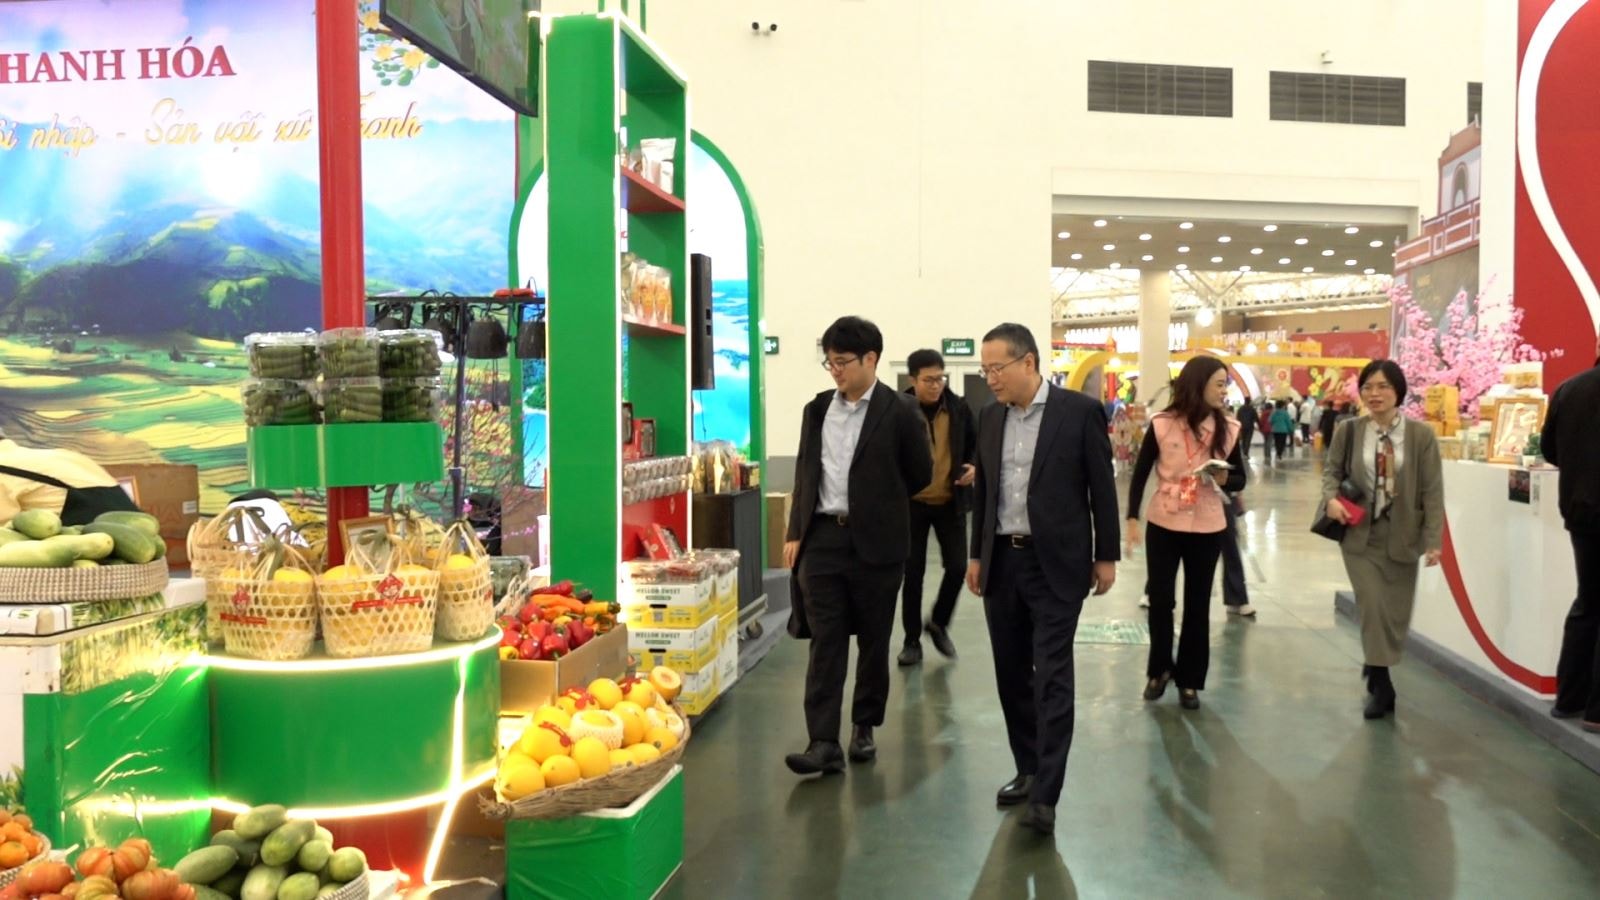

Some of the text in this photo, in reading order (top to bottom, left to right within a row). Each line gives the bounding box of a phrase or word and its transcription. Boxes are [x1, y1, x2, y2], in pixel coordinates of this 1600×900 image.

[137, 36, 237, 79] HÓA
[30, 113, 99, 157] nhập
[145, 97, 202, 144] Sản
[214, 109, 266, 152] vật
